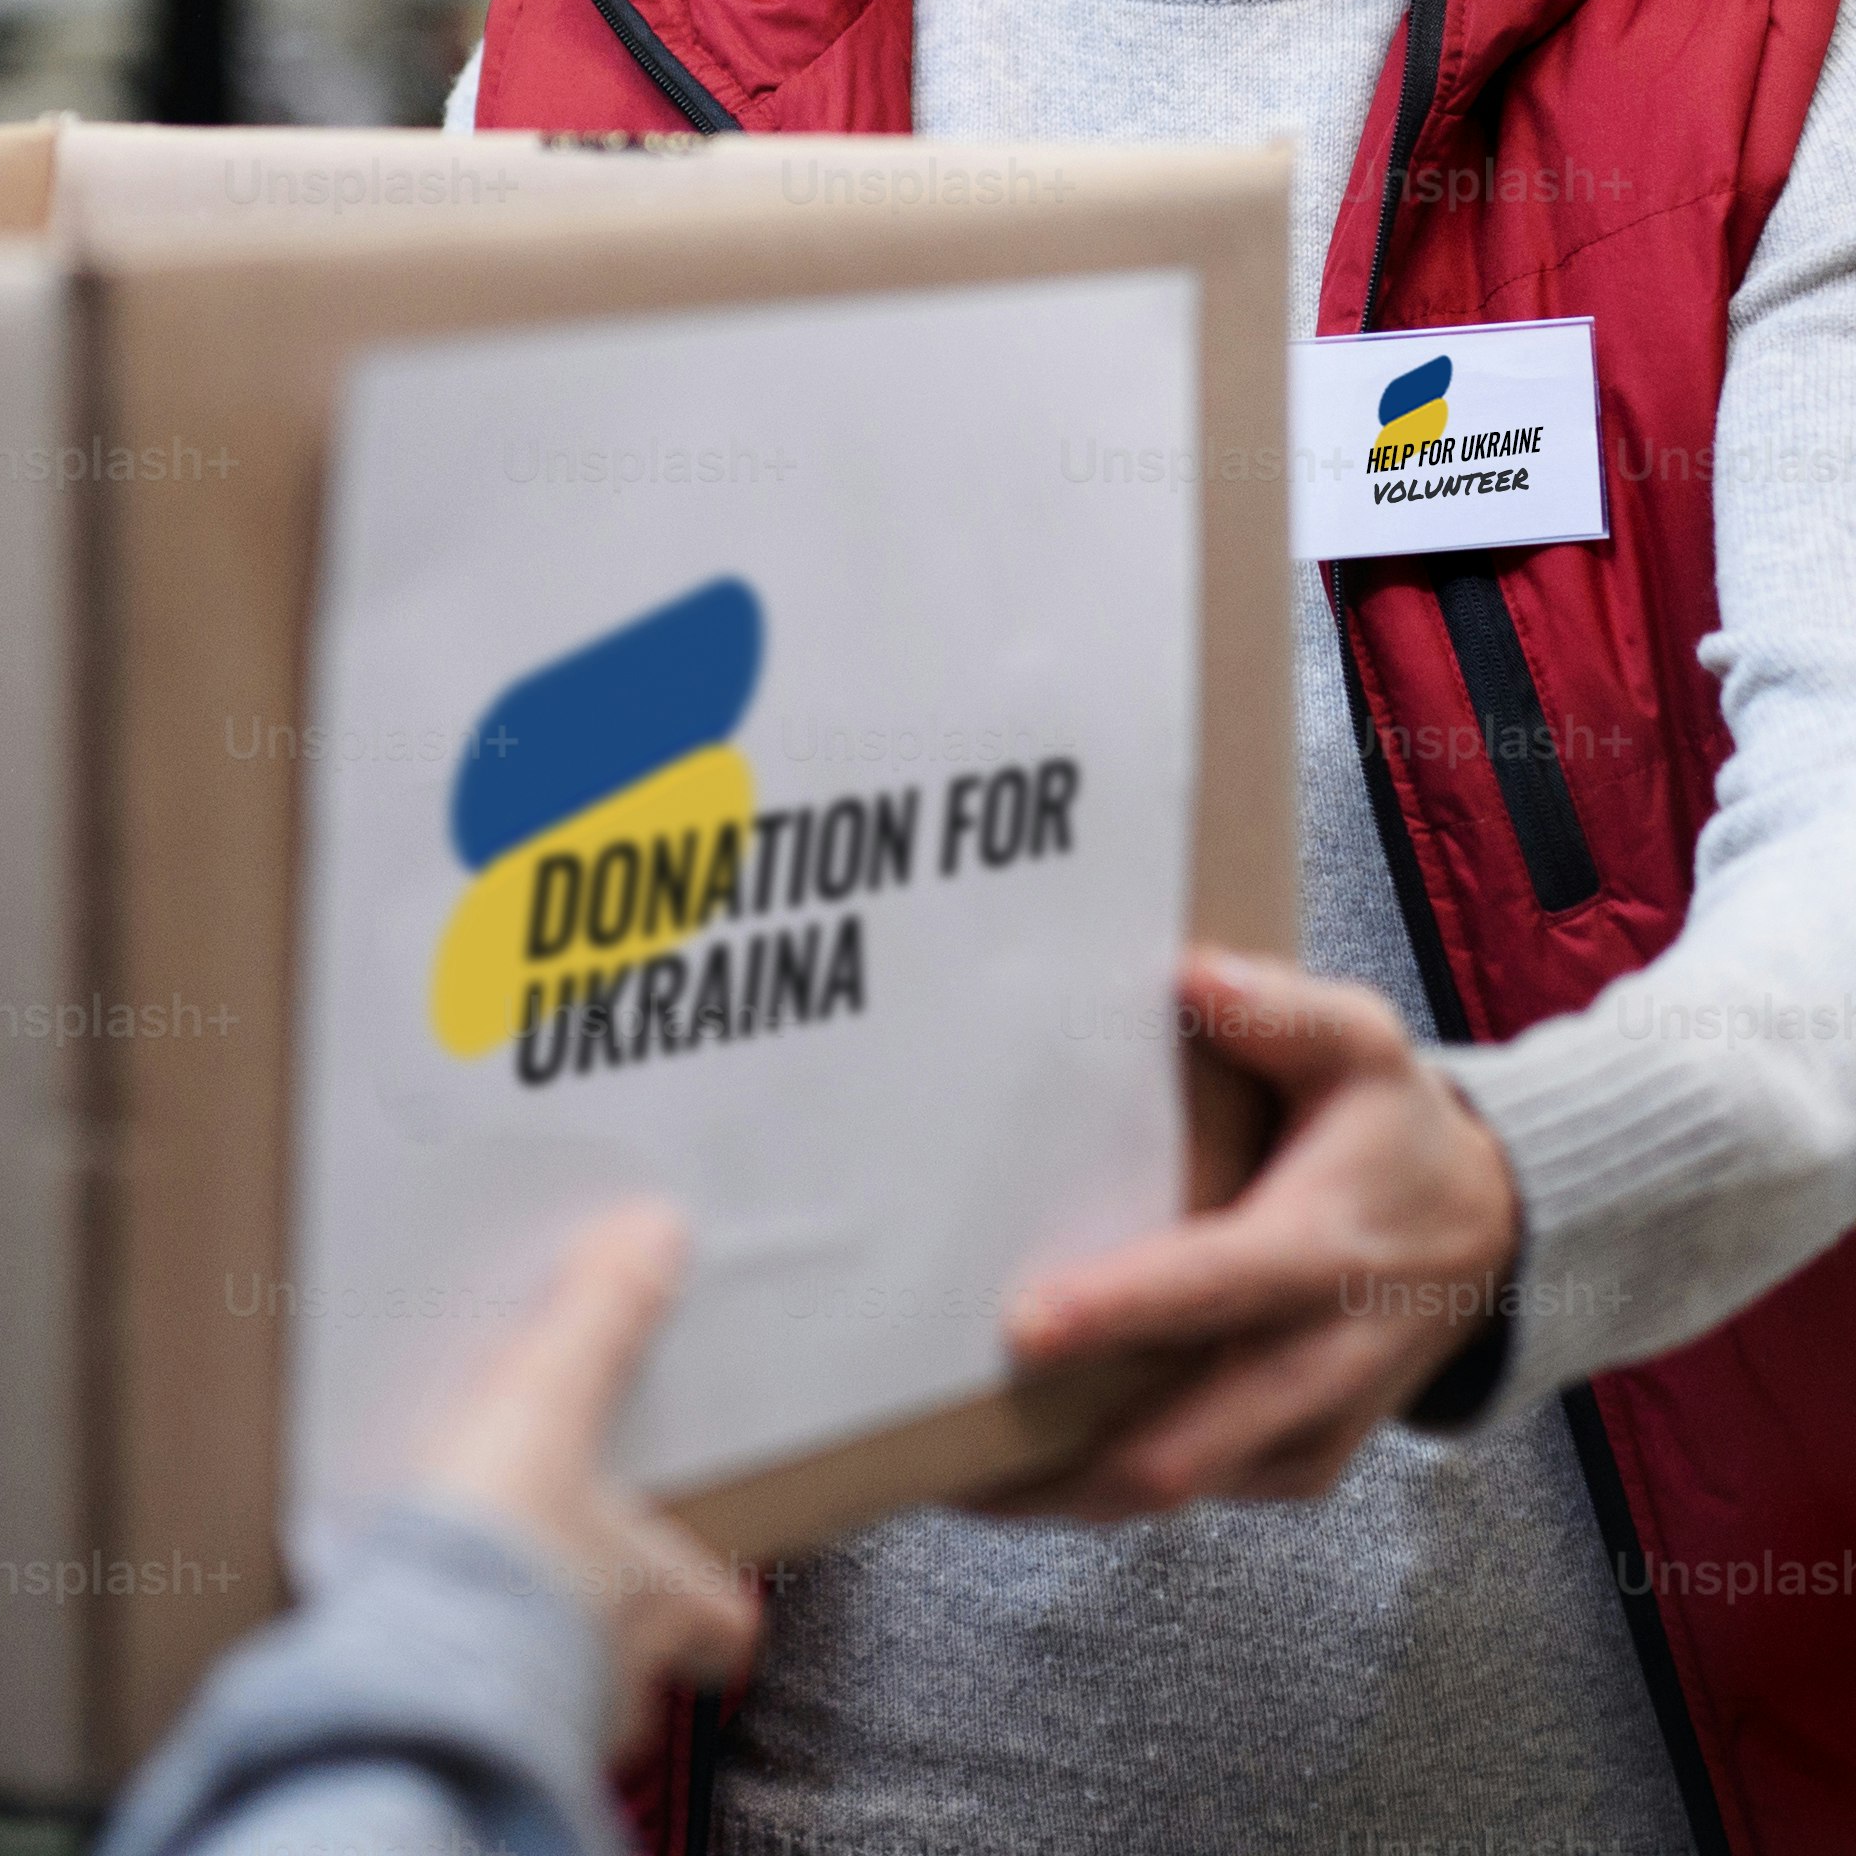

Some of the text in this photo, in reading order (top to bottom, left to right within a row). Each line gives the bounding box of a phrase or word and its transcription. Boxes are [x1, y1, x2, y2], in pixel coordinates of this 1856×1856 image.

[1366, 426, 1544, 474] HELP FOR UKRAINE
[1373, 467, 1530, 505] VOLUNTEER
[524, 755, 1079, 964] DONATION FOR
[515, 914, 864, 1088] UKRAINA
